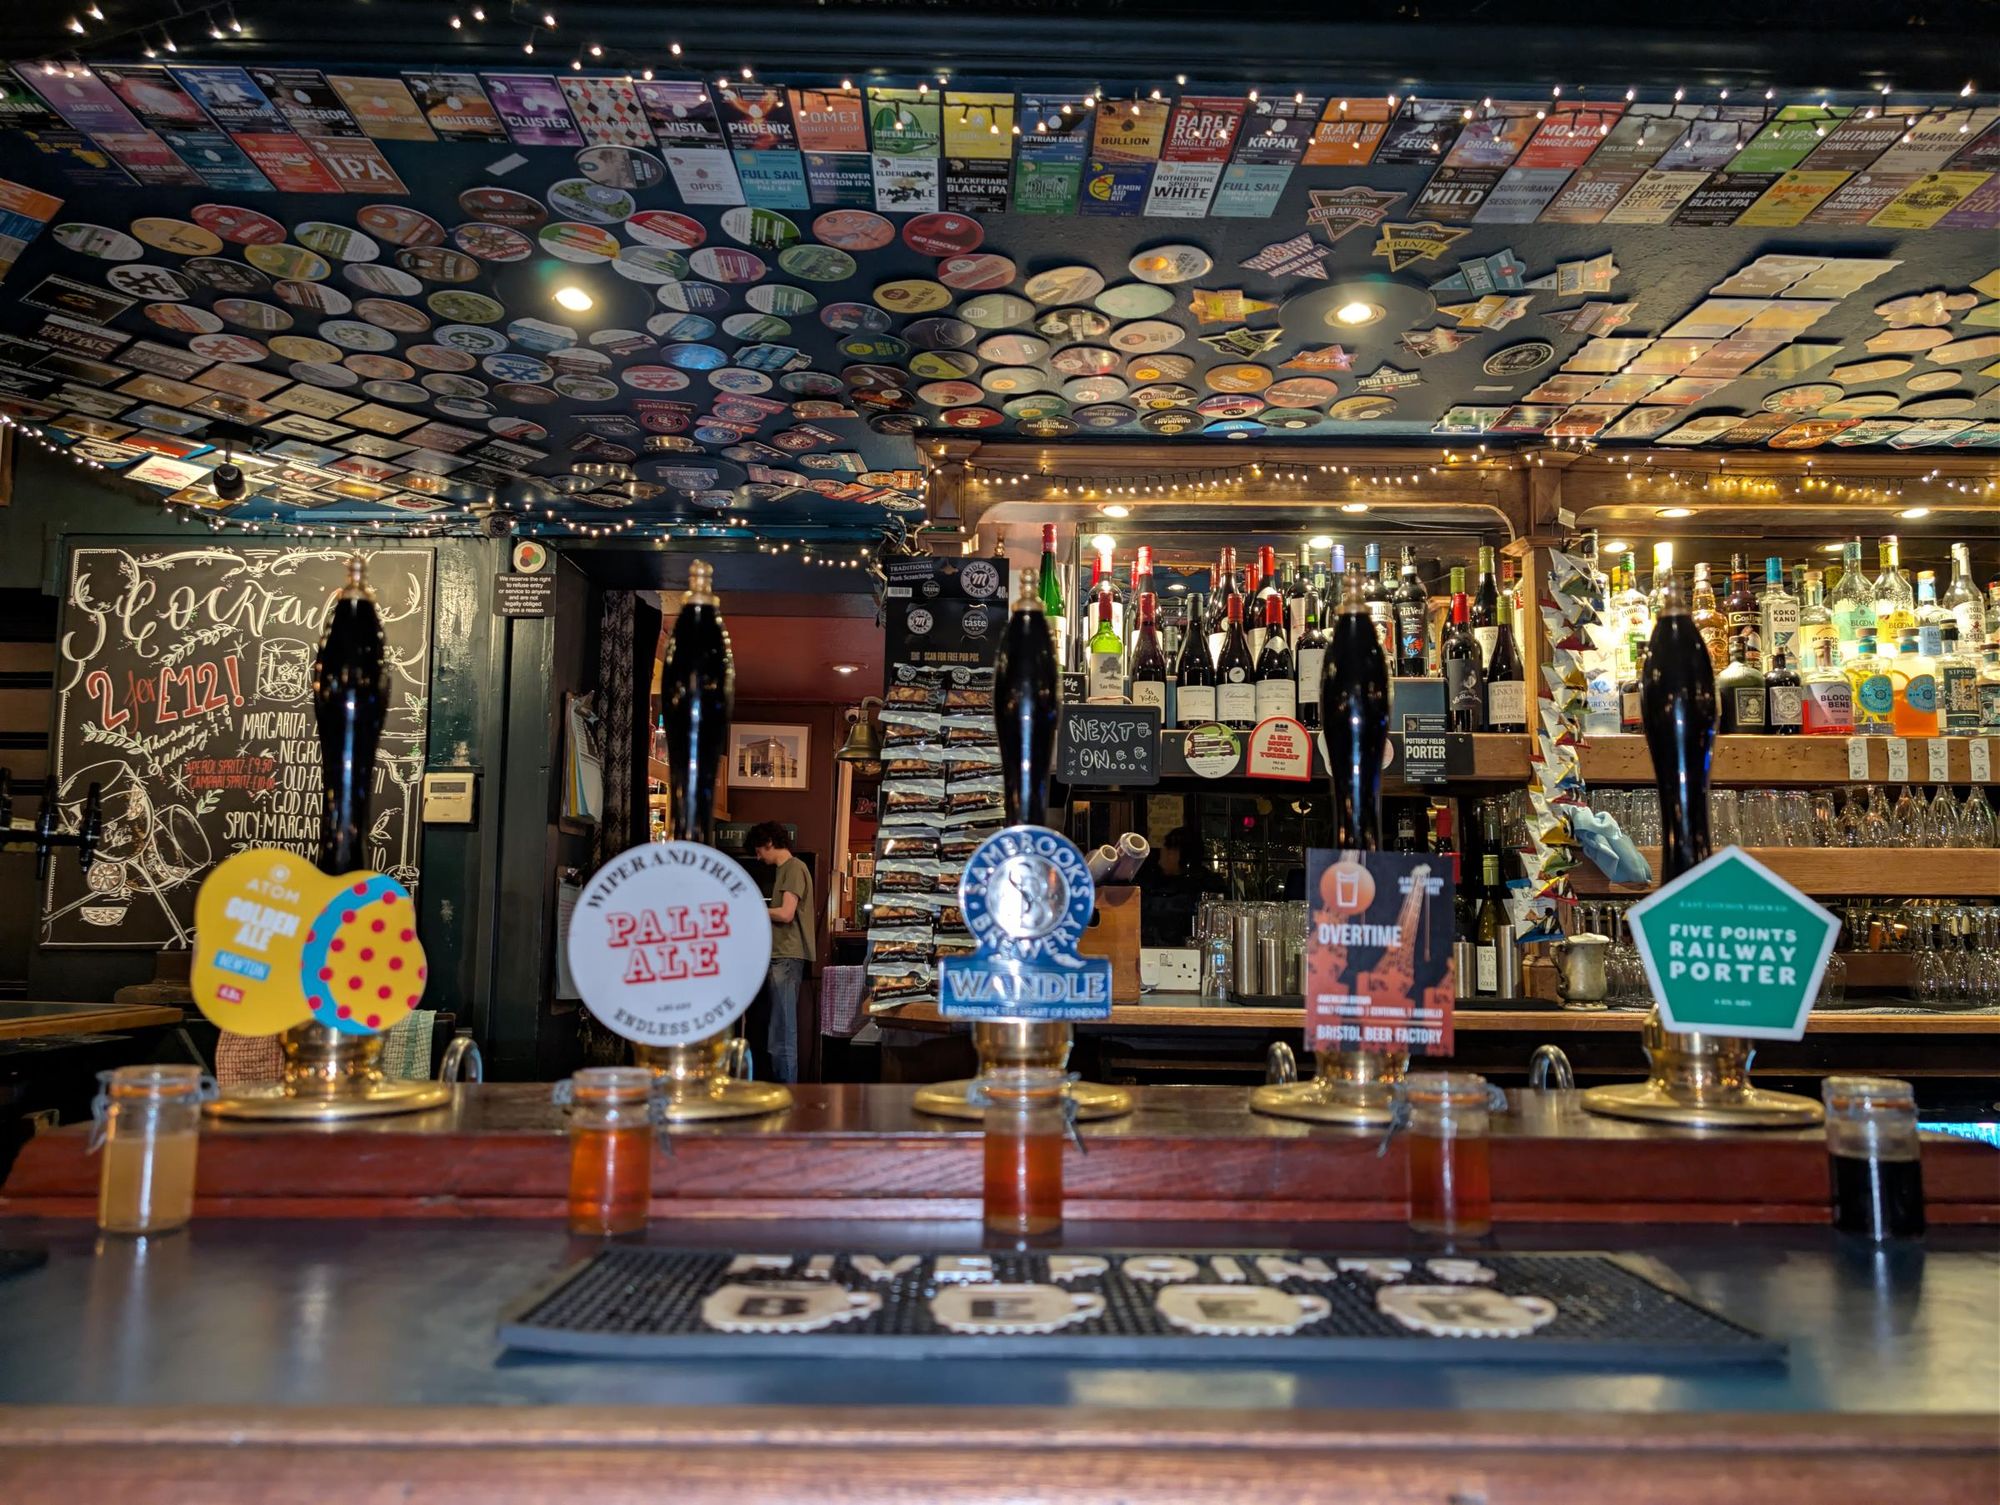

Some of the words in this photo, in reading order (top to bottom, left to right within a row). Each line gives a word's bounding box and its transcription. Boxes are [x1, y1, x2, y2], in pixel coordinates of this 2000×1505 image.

[280, 108, 350, 120] EMPEROR
[800, 111, 859, 124] COMET
[432, 115, 494, 127] MOUTERE
[508, 117, 571, 129] CLUSTER
[664, 122, 708, 134] VISTA
[728, 122, 792, 134] PHOENIX
[1022, 136, 1058, 144] STYRIAN
[1058, 135, 1084, 144] EAGLE
[1101, 137, 1150, 146] BULLION
[1832, 130, 1903, 141] AHTANUM
[1170, 138, 1206, 147] SINGLE
[1208, 139, 1230, 147] HOP
[1247, 137, 1298, 149] KRPAN
[1399, 137, 1434, 149] ZEUS
[1464, 139, 1515, 150] DRAGON
[1532, 137, 1571, 148] SINGLE
[1573, 138, 1598, 148] HOP
[1820, 142, 1862, 151] SINGLE
[1864, 142, 1889, 151] HOP
[326, 157, 393, 181] IPA
[741, 170, 772, 180] FULL
[774, 170, 803, 181] SAIL
[809, 171, 871, 181] MAYFLOWER
[946, 176, 1009, 186] BLACKFRIARS
[811, 179, 854, 187] SESSION
[855, 180, 871, 188] IPA
[946, 184, 987, 194] BLACK
[988, 185, 1007, 195] IPA
[1112, 184, 1141, 192] LEMON
[1223, 182, 1250, 192] FULL
[1253, 182, 1280, 192] SAIL
[1462, 182, 1491, 190] STREET
[1496, 184, 1558, 193] SOUTHBANK
[1573, 181, 1624, 193] THREE
[1636, 183, 1661, 191] FLAT
[1662, 183, 1696, 191] WHITE
[1154, 186, 1211, 199] WHITE
[1420, 188, 1485, 205] MILD
[1561, 191, 1620, 202] SHEETS
[1627, 190, 1681, 199] COFFEE
[1695, 191, 1759, 199] BLACKFRIARS
[1840, 187, 1905, 196] BOROUGH
[1688, 198, 1729, 208] BLACK
[1731, 199, 1751, 208] IPA
[1835, 194, 1890, 203] MARKET
[1555, 201, 1592, 209] GOLDEN
[1593, 201, 1614, 209] ALE
[1861, 202, 1886, 211] ALE
[1314, 205, 1351, 219] URBAN
[1383, 239, 1442, 252] TRINITY
[889, 563, 934, 573] TRADITIONAL
[963, 563, 997, 581] MIDLAND
[889, 574, 903, 582] Pork
[902, 572, 935, 581] Scratchings
[964, 582, 996, 596] SNACKS
[963, 619, 988, 629] taste
[1773, 615, 1796, 623] KANU
[1850, 618, 1875, 628] BLOOM
[1888, 621, 1914, 629] BLOOM
[924, 652, 937, 662] SCAN
[938, 652, 947, 662] FOR
[947, 652, 959, 662] FREE
[86, 669, 130, 731] 2
[155, 654, 245, 725] £12!
[1068, 718, 1136, 745] NEXT
[1405, 737, 1428, 745] POTTERS'
[1405, 745, 1446, 760] PORTER
[272, 790, 301, 815] GOD
[718, 829, 744, 841] LIFT
[965, 831, 1090, 899] SAMBROOK'S
[585, 856, 647, 910] WIPER
[650, 848, 697, 867] AND
[699, 856, 748, 899] TRUE
[245, 877, 301, 906] ATOM
[224, 896, 301, 938] GOLDEN
[605, 901, 732, 948] PALE
[233, 922, 275, 953] ALE
[972, 910, 1082, 960] BREWERY
[1317, 922, 1403, 948] OVERTIME
[1668, 922, 1714, 939] FIVE
[1720, 925, 1798, 943] POINTS
[1668, 940, 1797, 963] RAILWAY
[215, 951, 268, 979] NEWTON
[622, 940, 721, 985] ALE
[1668, 960, 1797, 986] PORTER
[946, 967, 1107, 1004] WANDLE
[612, 1007, 691, 1037] ENDLESS
[693, 996, 738, 1026] LOVE
[1021, 1006, 1049, 1016] HEART
[1064, 1006, 1107, 1018] LONDON
[1316, 1024, 1363, 1042] BRISTOL
[1364, 1026, 1393, 1043] BEER
[1394, 1026, 1443, 1045] FACTORY
[728, 1254, 994, 1282] FIVE
[1048, 1255, 1498, 1283] POINTS
